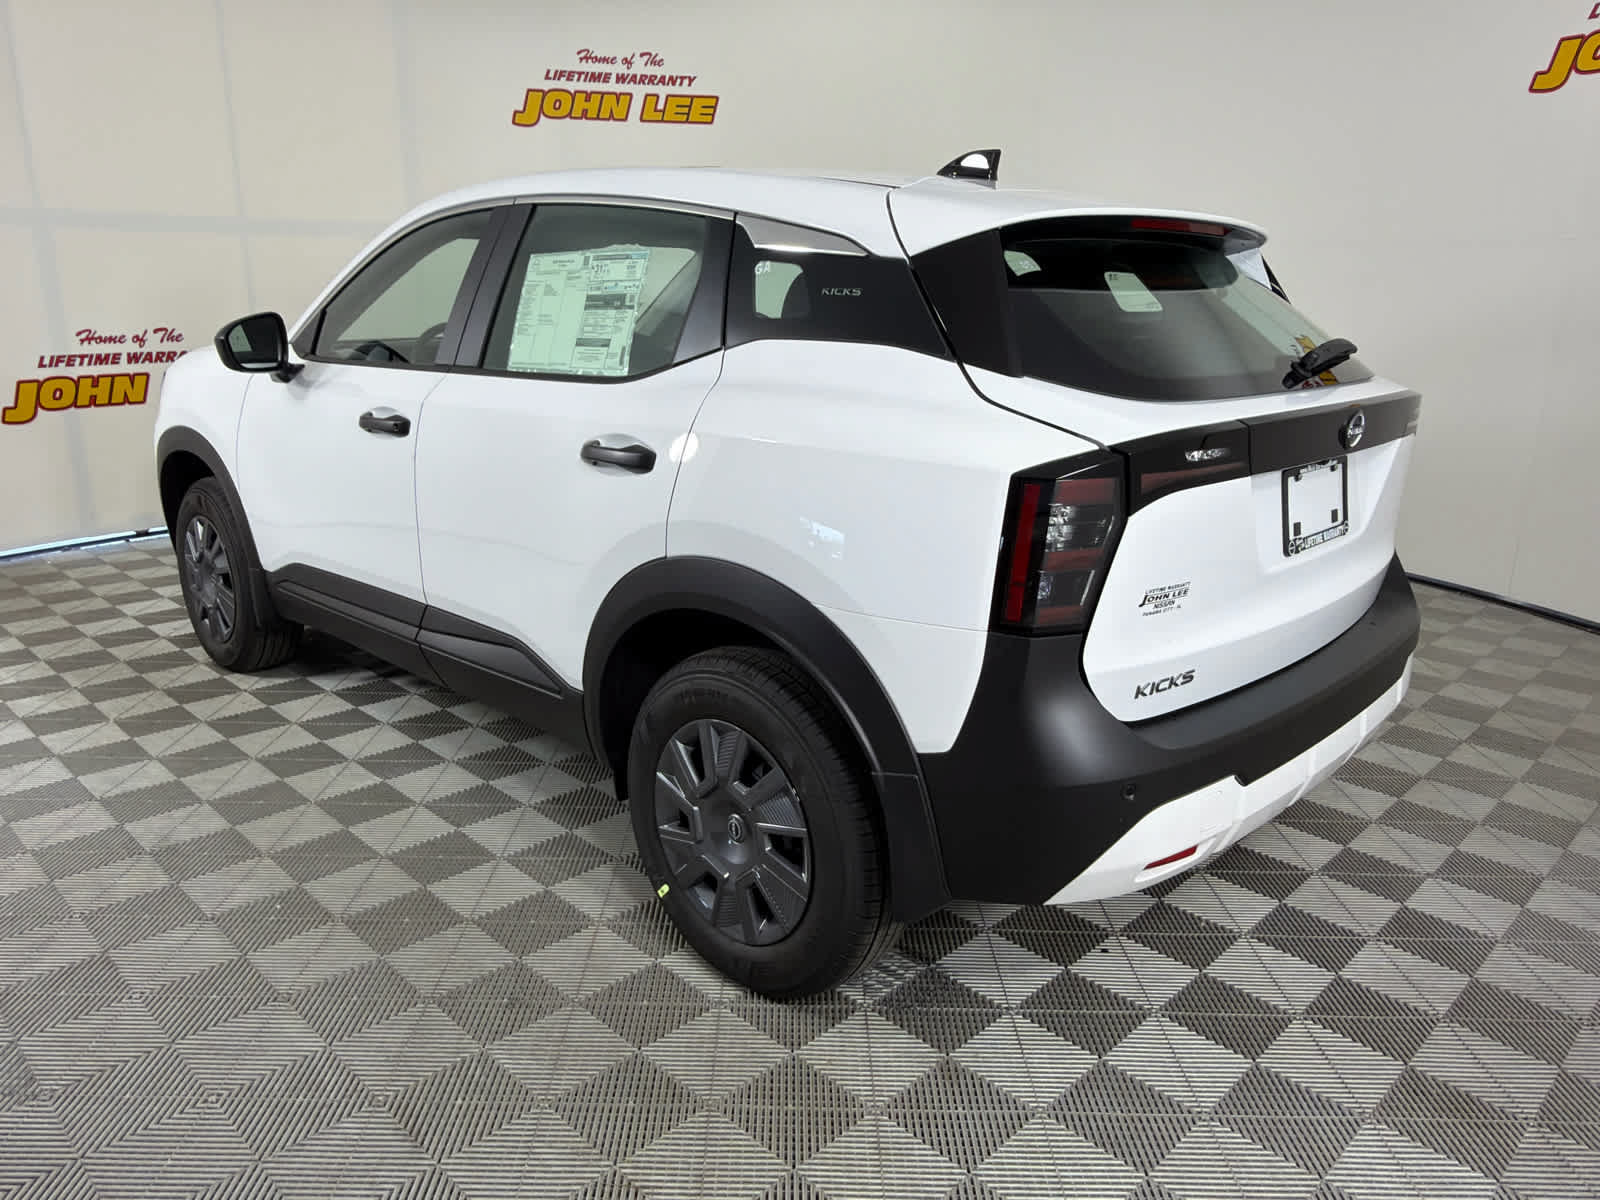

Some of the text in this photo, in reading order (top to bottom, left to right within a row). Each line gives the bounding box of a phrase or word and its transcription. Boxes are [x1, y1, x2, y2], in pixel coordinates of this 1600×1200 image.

[576, 48, 665, 69] Home of The
[544, 69, 697, 87] LIFETIME WARRANTY
[512, 88, 719, 127] JOHN LEE
[821, 287, 862, 296] KICKS
[75, 327, 185, 348] Home of The
[37, 352, 122, 368] LIFETIME
[1, 372, 150, 425] JOHN
[1138, 588, 1190, 608] JOHN LEE
[1133, 669, 1196, 700] KICKS
